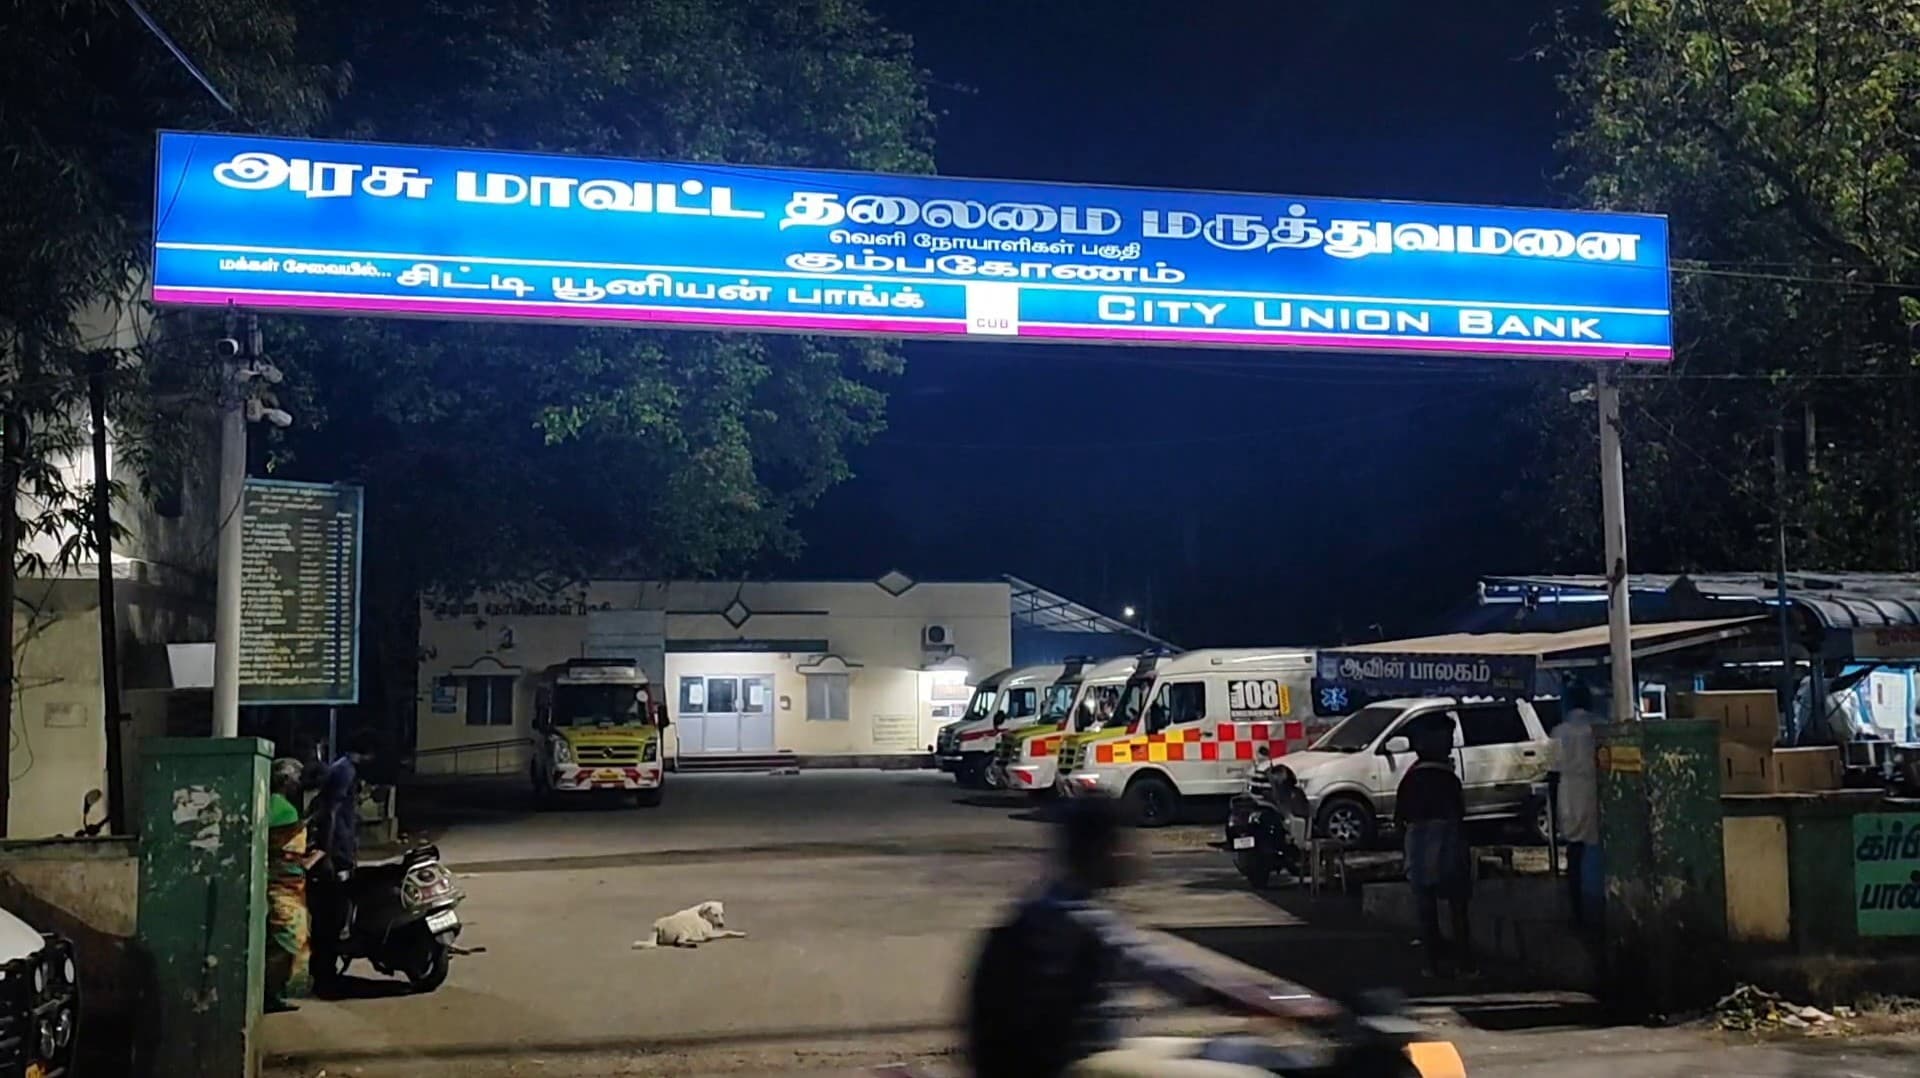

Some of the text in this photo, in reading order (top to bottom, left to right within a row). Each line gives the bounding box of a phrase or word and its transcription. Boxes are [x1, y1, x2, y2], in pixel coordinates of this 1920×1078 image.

[213, 152, 1641, 261] அரசு மாவட்ட தலைமை மருத்துவமனை
[829, 229, 1141, 261] வெளி நோயாளிகள் பகுதி
[219, 256, 280, 272] மக்கள்
[396, 263, 535, 297] சிட்டி
[552, 273, 772, 302] யூனியன்
[787, 284, 925, 309] பாங்க்
[785, 248, 1186, 284] கும்பகோணம்
[976, 317, 1009, 329] CUB
[1098, 294, 1602, 339] CITY UNION BANK
[1340, 656, 1491, 682] ஆவின் பாலகம்
[1231, 681, 1279, 709] 108
